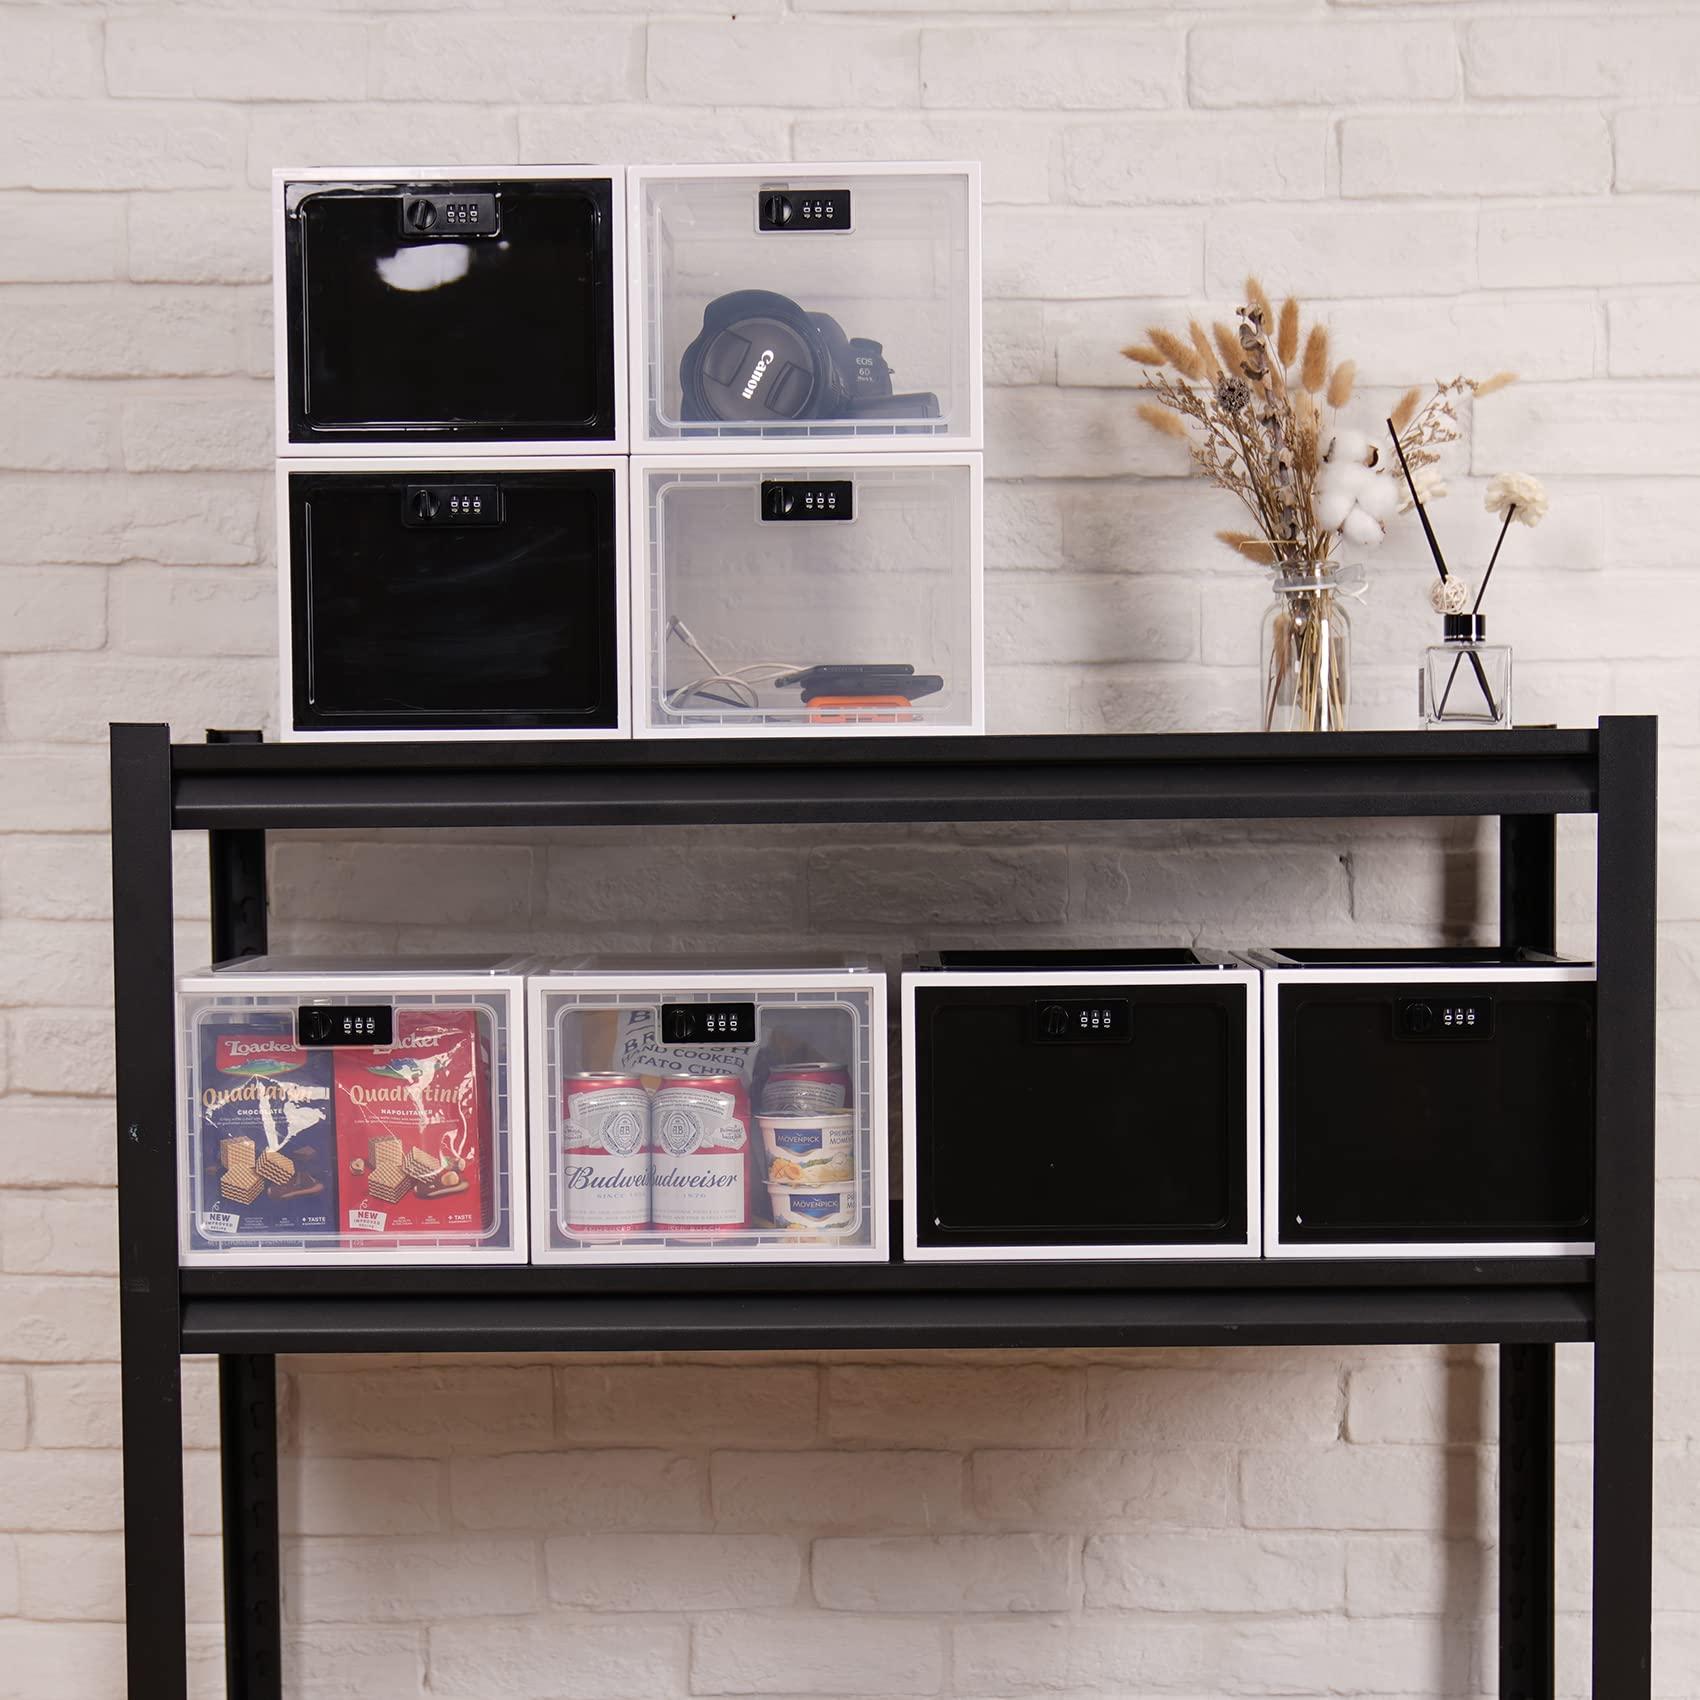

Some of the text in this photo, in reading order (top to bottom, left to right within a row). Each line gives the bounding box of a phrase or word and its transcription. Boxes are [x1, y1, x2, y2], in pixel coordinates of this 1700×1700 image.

[856, 357, 873, 365] EOS
[742, 350, 774, 400] Canon
[673, 1048, 745, 1069] COOKED
[350, 1084, 460, 1106] Quadrtini
[210, 1213, 231, 1222] NEW
[358, 1211, 378, 1220] NEW
